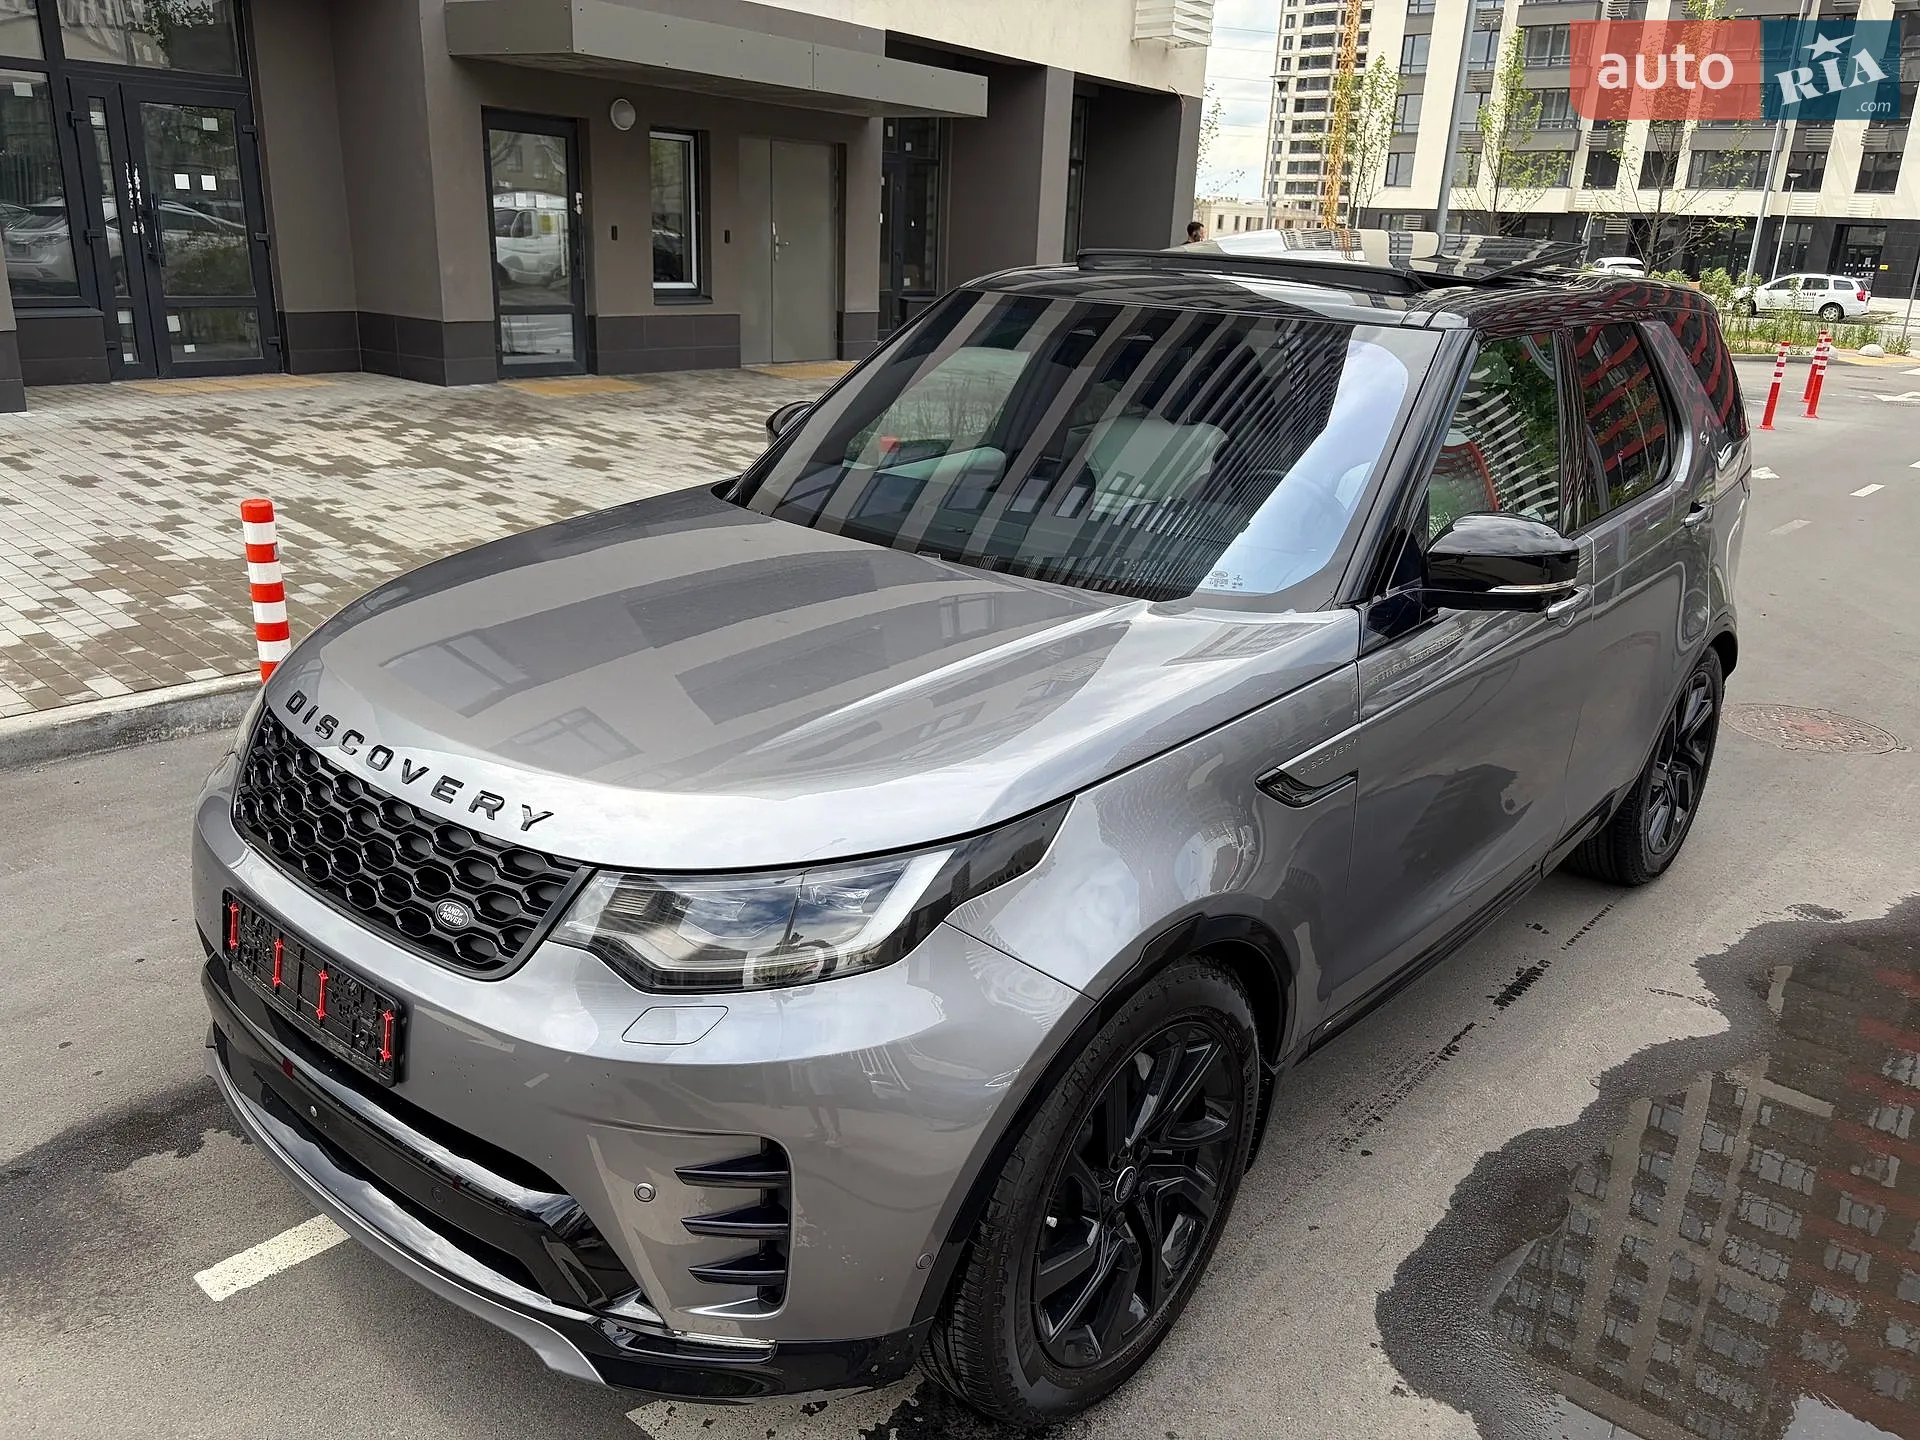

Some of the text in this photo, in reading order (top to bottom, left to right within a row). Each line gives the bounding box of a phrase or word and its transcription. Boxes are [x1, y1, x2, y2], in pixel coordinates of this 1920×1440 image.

[285, 690, 554, 832] DISCOVERY
[443, 904, 460, 916] LAND
[441, 912, 463, 925] ROVER
